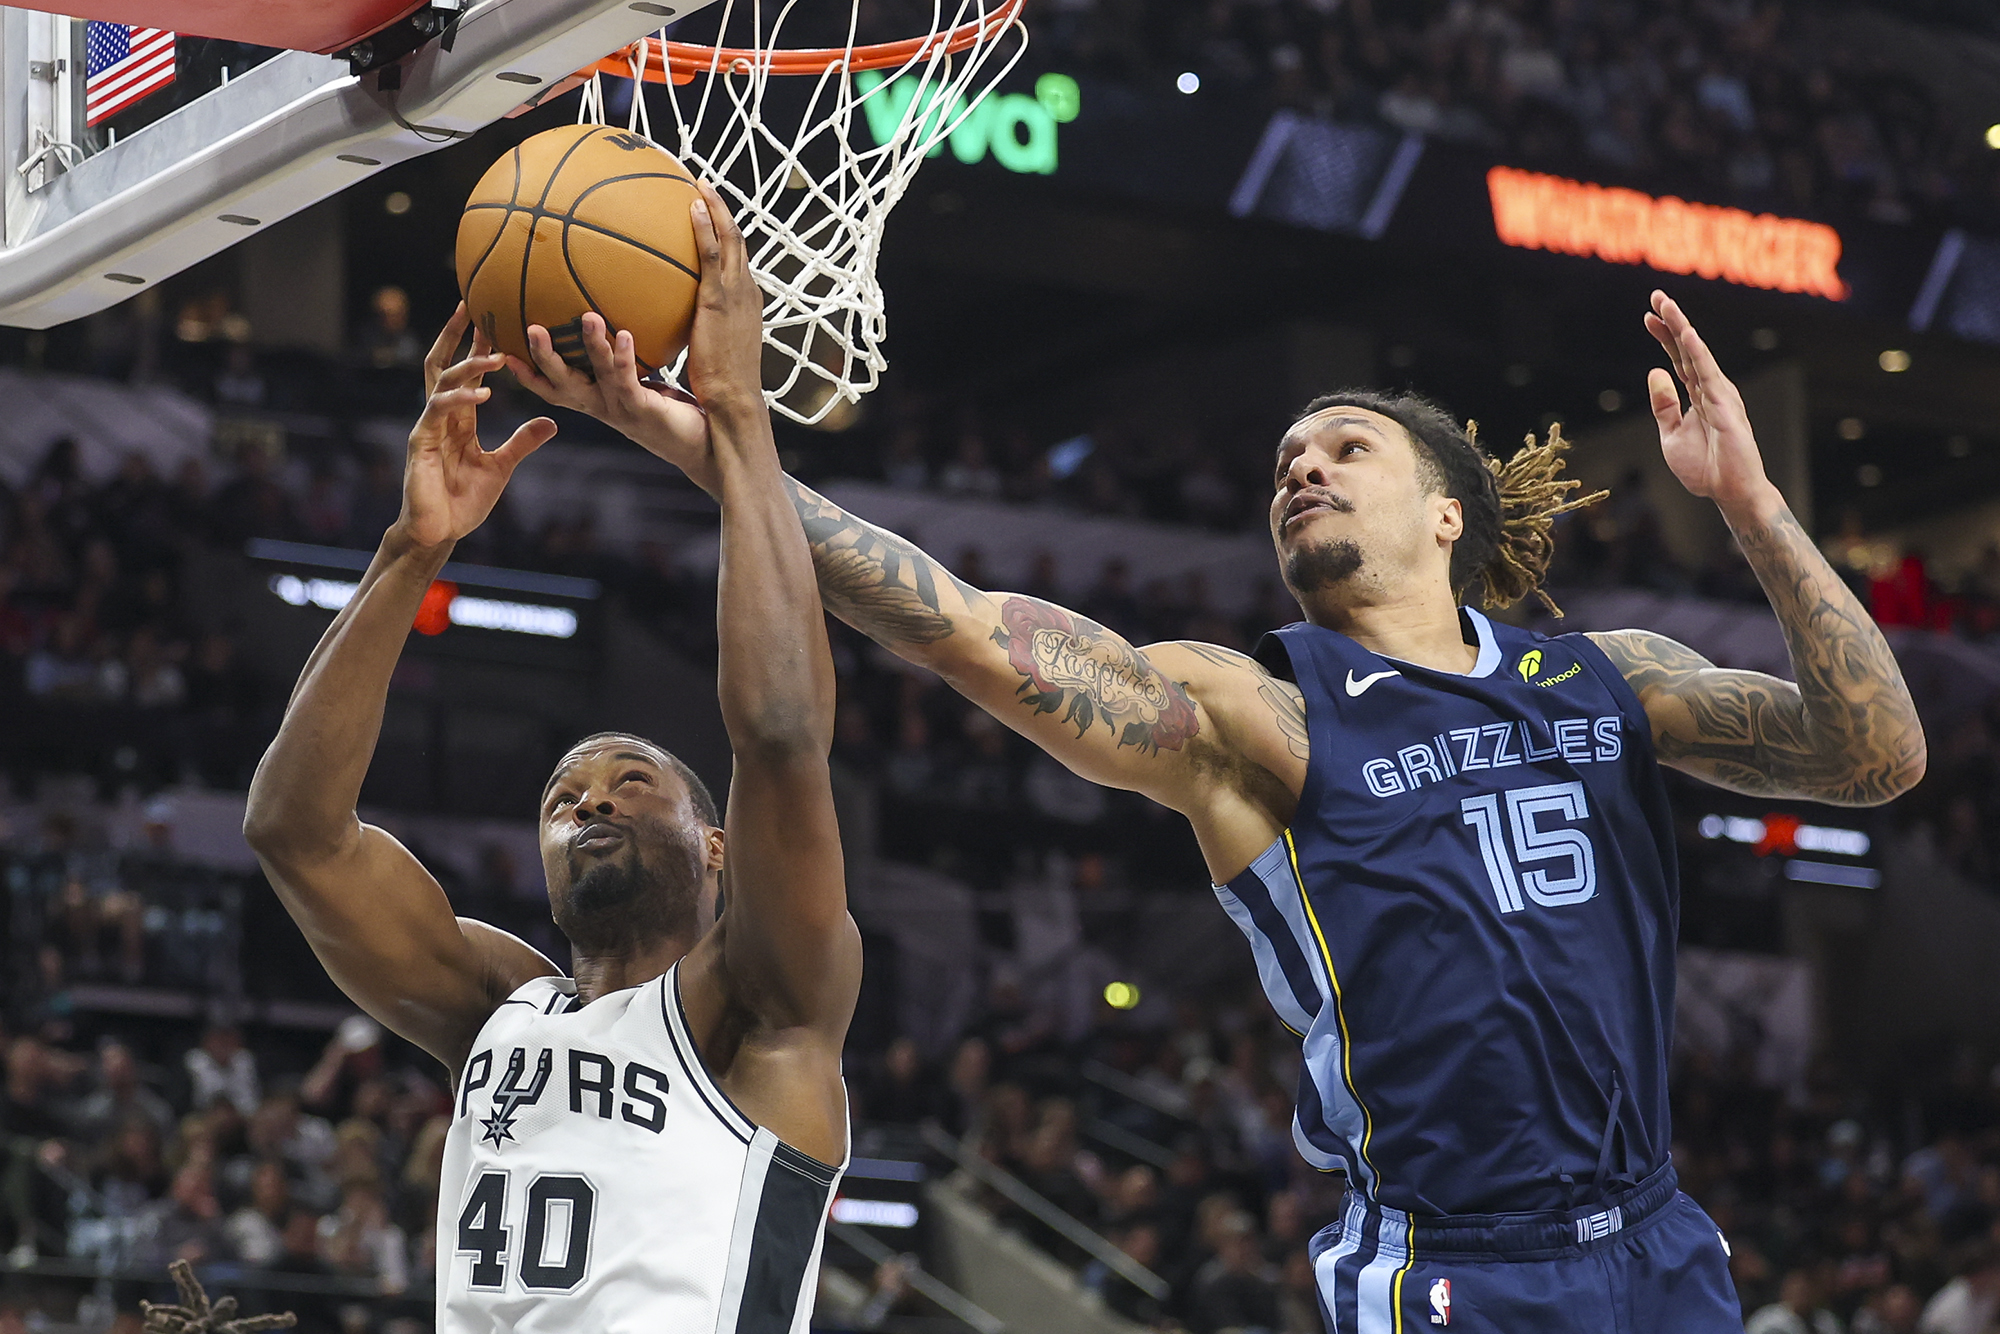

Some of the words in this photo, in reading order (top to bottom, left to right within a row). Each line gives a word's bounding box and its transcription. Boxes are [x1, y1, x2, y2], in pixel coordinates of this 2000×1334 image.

[1362, 716, 1621, 798] GRIZZLES
[1460, 780, 1596, 913] 15
[456, 1169, 599, 1295] 40
